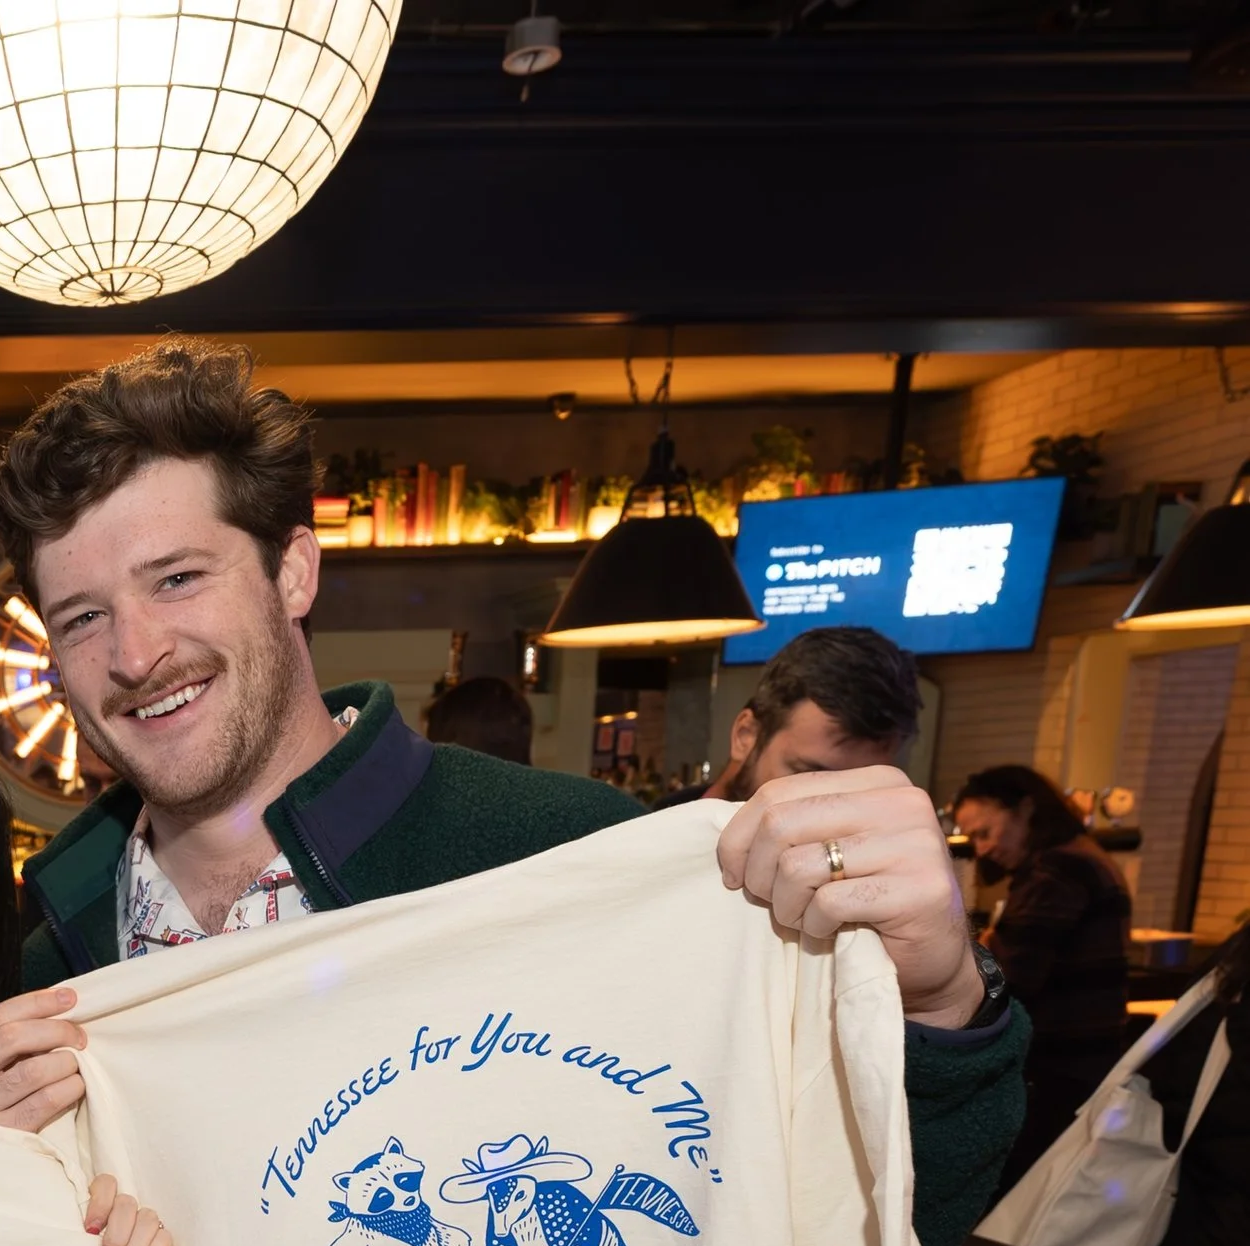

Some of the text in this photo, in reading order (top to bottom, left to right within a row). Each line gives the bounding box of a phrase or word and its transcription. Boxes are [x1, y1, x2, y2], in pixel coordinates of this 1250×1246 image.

[410, 1025, 461, 1072] for
[461, 1012, 552, 1072] You
[561, 1044, 672, 1096] and
[610, 1175, 695, 1234] TENNESSEE
